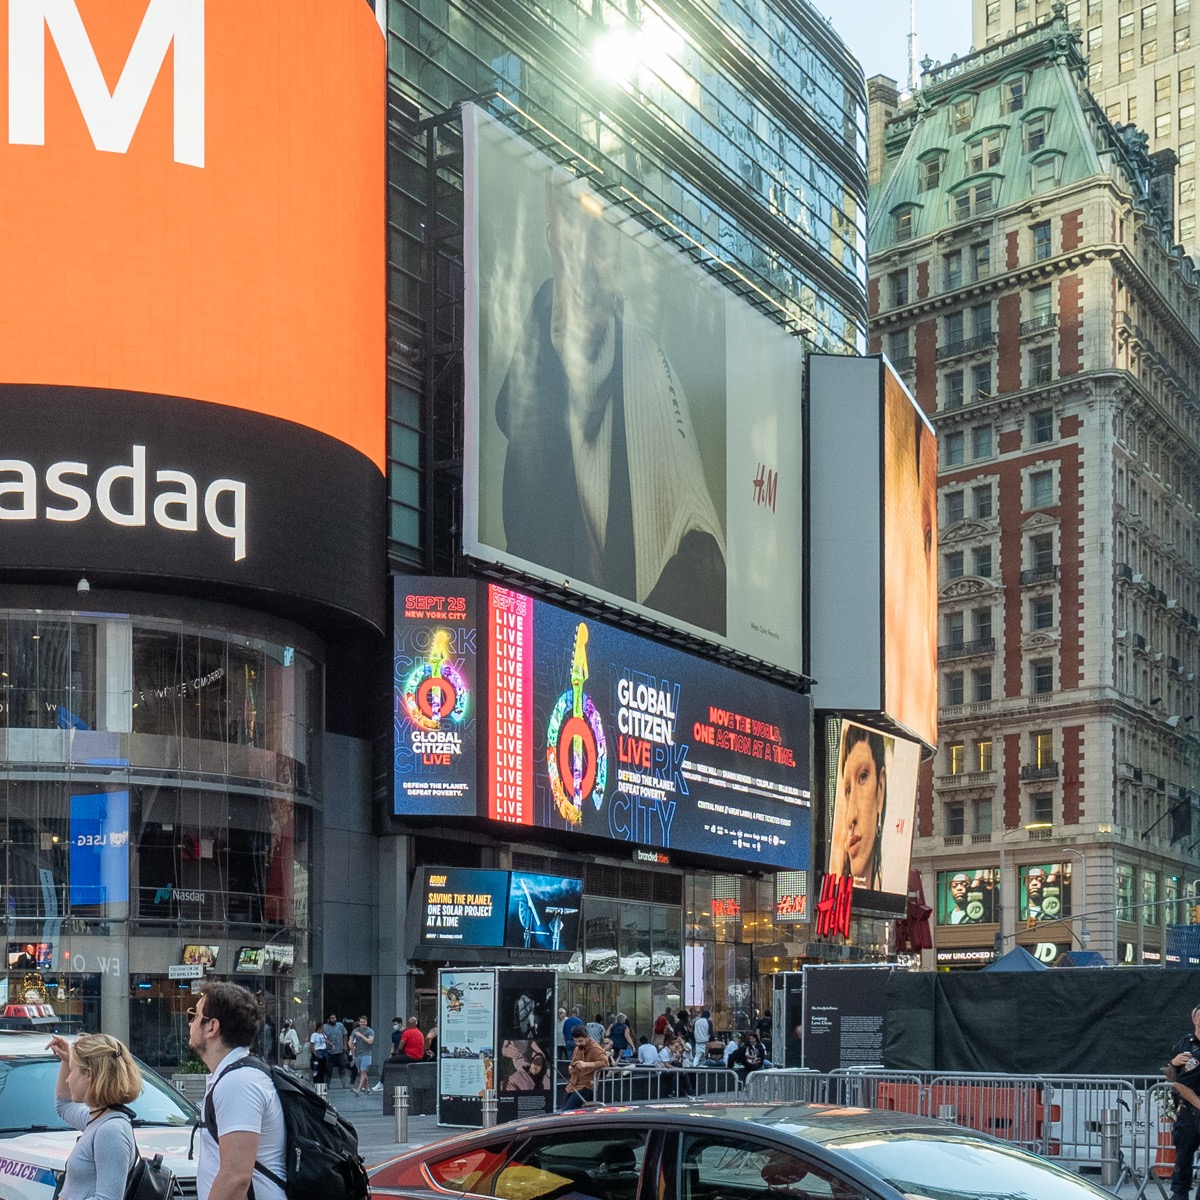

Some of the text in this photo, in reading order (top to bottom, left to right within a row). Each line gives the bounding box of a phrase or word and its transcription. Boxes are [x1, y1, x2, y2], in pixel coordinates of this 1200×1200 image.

[753, 462, 778, 515] H&M
[405, 595, 466, 612] SEPT 25
[404, 611, 467, 621] NEW YORK CITY
[496, 610, 523, 630] LIVE
[496, 626, 523, 646] LIVE
[496, 641, 523, 662] LIVE
[496, 657, 522, 677] LIVE
[496, 673, 522, 692] LIVE
[496, 689, 522, 708] LIVE
[618, 679, 675, 719] GLOBAL
[496, 704, 522, 723] LIVE
[708, 706, 734, 729] MOVE
[735, 713, 751, 734] THE
[411, 731, 462, 743] GLOBAL
[496, 720, 522, 738] LIVE
[496, 736, 522, 754] LIVE
[618, 735, 651, 768] LIVE
[693, 722, 796, 768] ONE ACTION AT A TIME.
[423, 754, 451, 766] LIVE
[496, 752, 522, 770] LIVE
[496, 768, 522, 785] LIVE
[618, 770, 676, 792] DEFEND THE PLANET.
[496, 784, 522, 800] LIVE
[618, 782, 666, 800] DEFEAT POVERTY.
[496, 800, 522, 816] LIVE
[608, 790, 676, 848] CITY
[638, 850, 669, 864] brandedcities
[172, 889, 205, 905] Nasdaq
[428, 893, 493, 906] SAVING THE PLANET,
[777, 895, 806, 915] H&M
[428, 905, 492, 917] ONE SOLAR PROJECT
[427, 916, 458, 927] AT A TIME
[953, 952, 990, 960] UNLOCKED
[1034, 942, 1057, 962] JD
